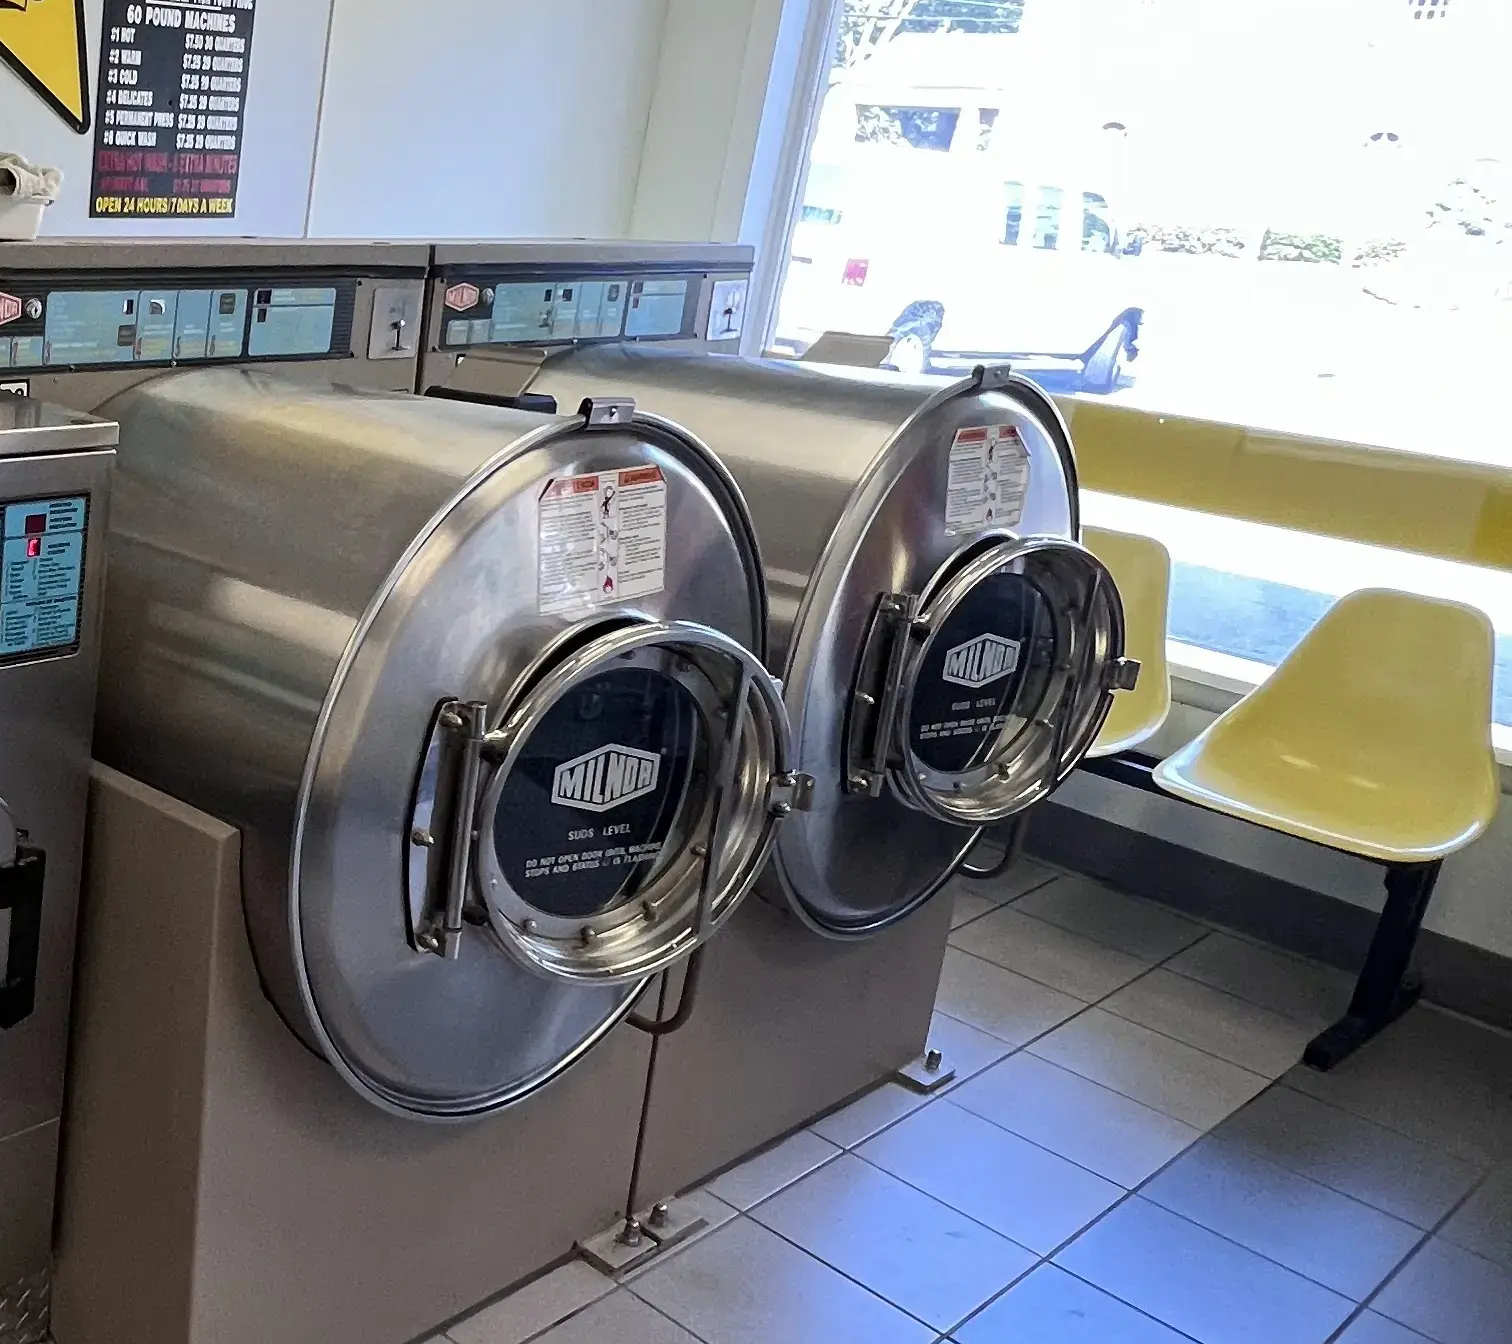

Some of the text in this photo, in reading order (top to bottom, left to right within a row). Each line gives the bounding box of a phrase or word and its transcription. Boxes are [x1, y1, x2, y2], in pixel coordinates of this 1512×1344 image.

[126, 4, 236, 33] 60 POUND MACHINES
[120, 27, 136, 43] HOT
[119, 69, 137, 85] COLD
[117, 90, 153, 106] DELICATES
[95, 197, 122, 213] OPEN
[123, 197, 136, 213] 24
[199, 198, 207, 213] A
[208, 198, 234, 213] WEEK
[559, 751, 654, 804] MILNOR
[567, 823, 631, 841] SUDS LEVEL
